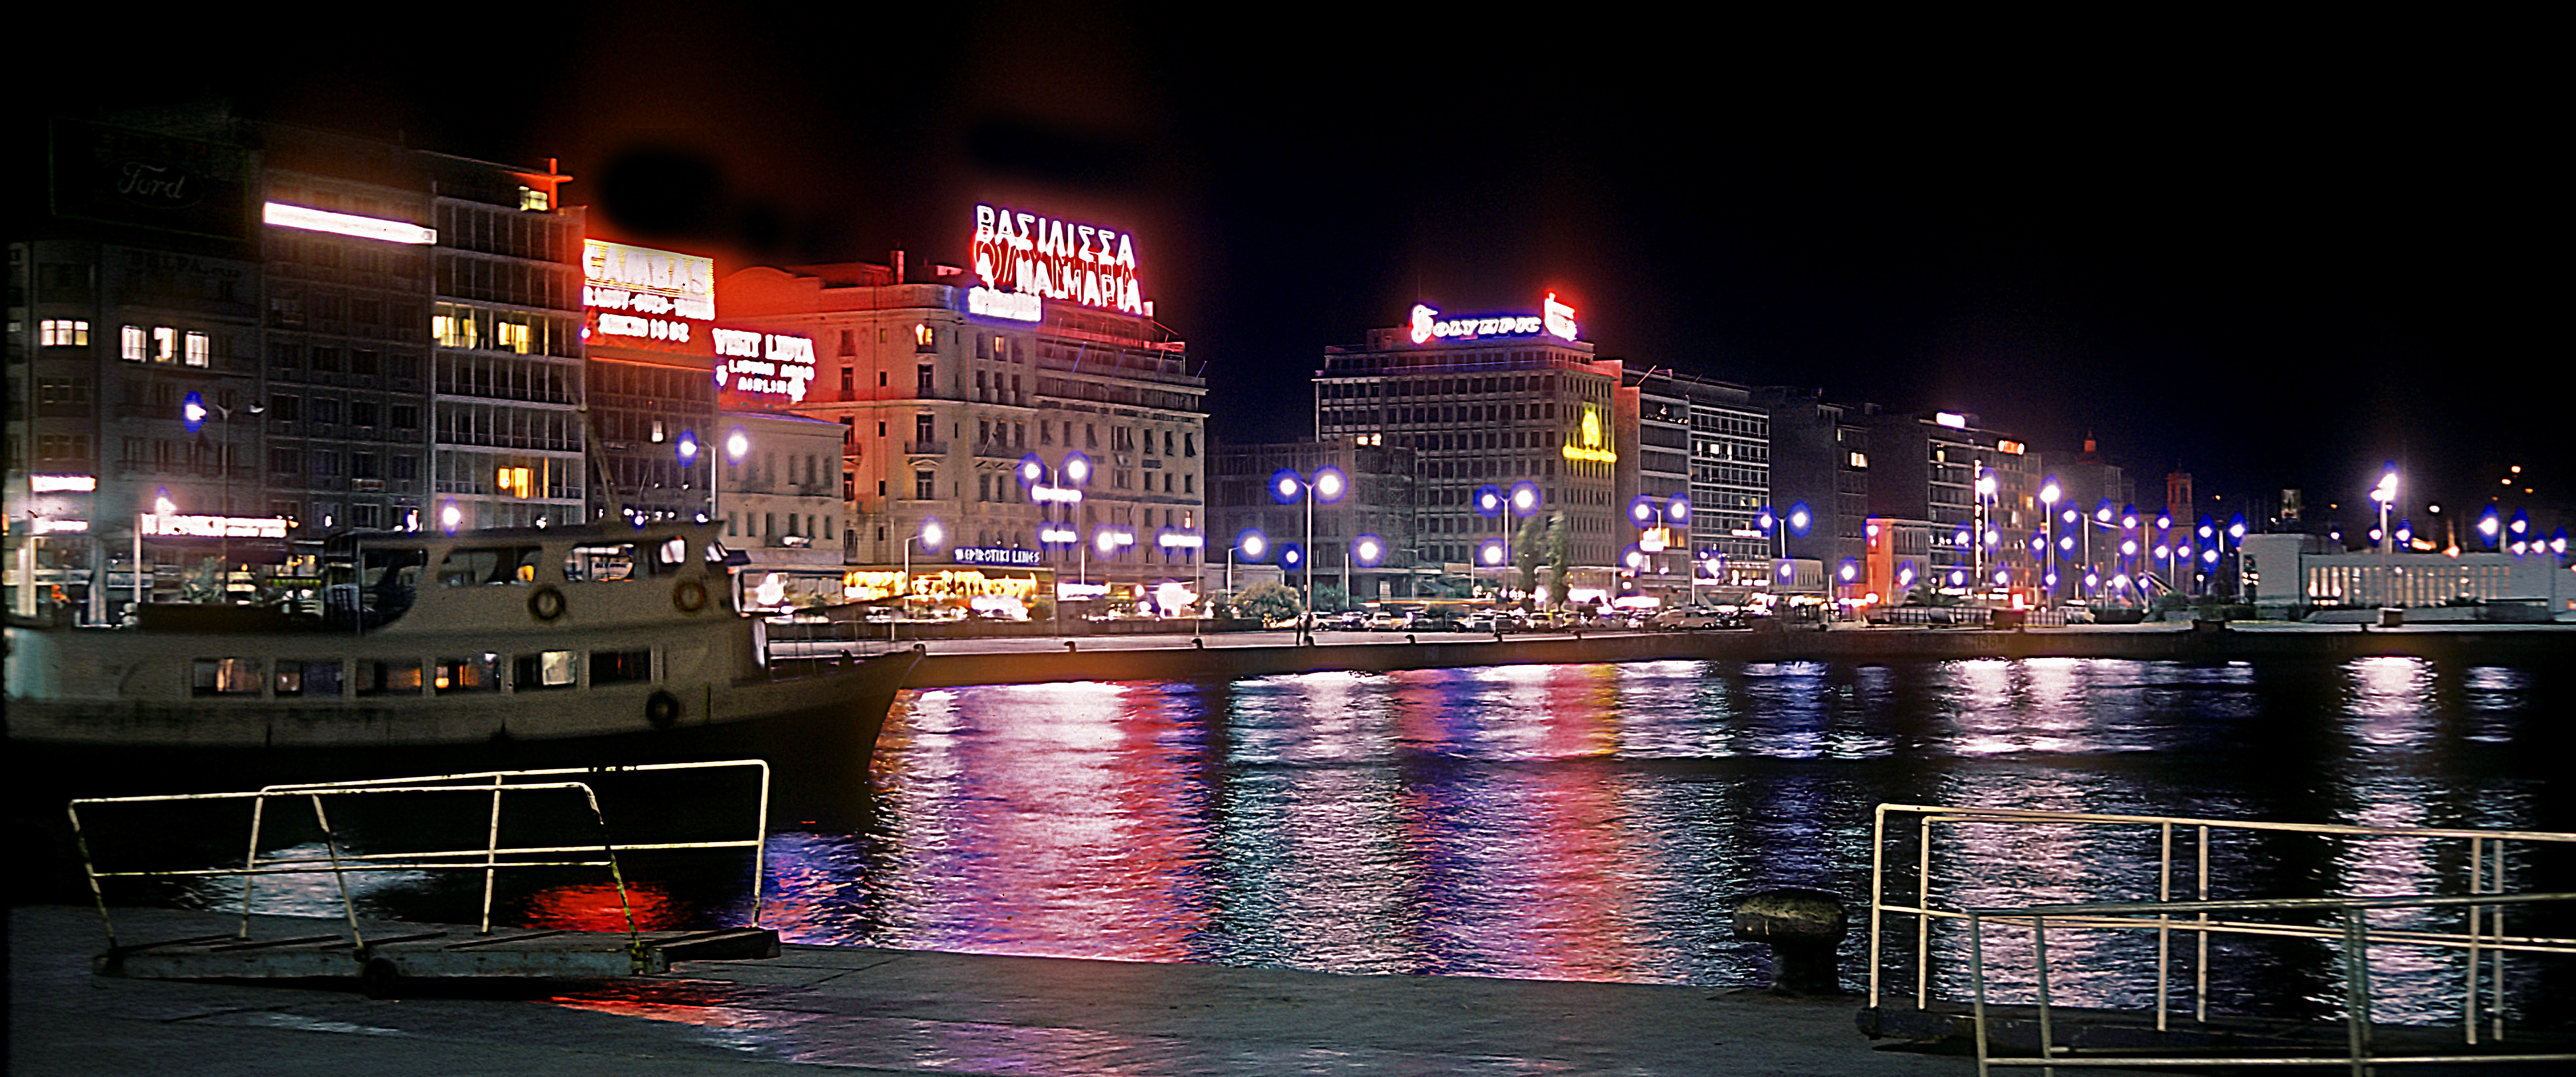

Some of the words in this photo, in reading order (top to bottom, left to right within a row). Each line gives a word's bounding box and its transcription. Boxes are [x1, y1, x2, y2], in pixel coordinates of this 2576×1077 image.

[117, 161, 186, 199] Ford
[1433, 317, 1542, 337] OLYMPIC
[1012, 551, 1040, 563] LINES
